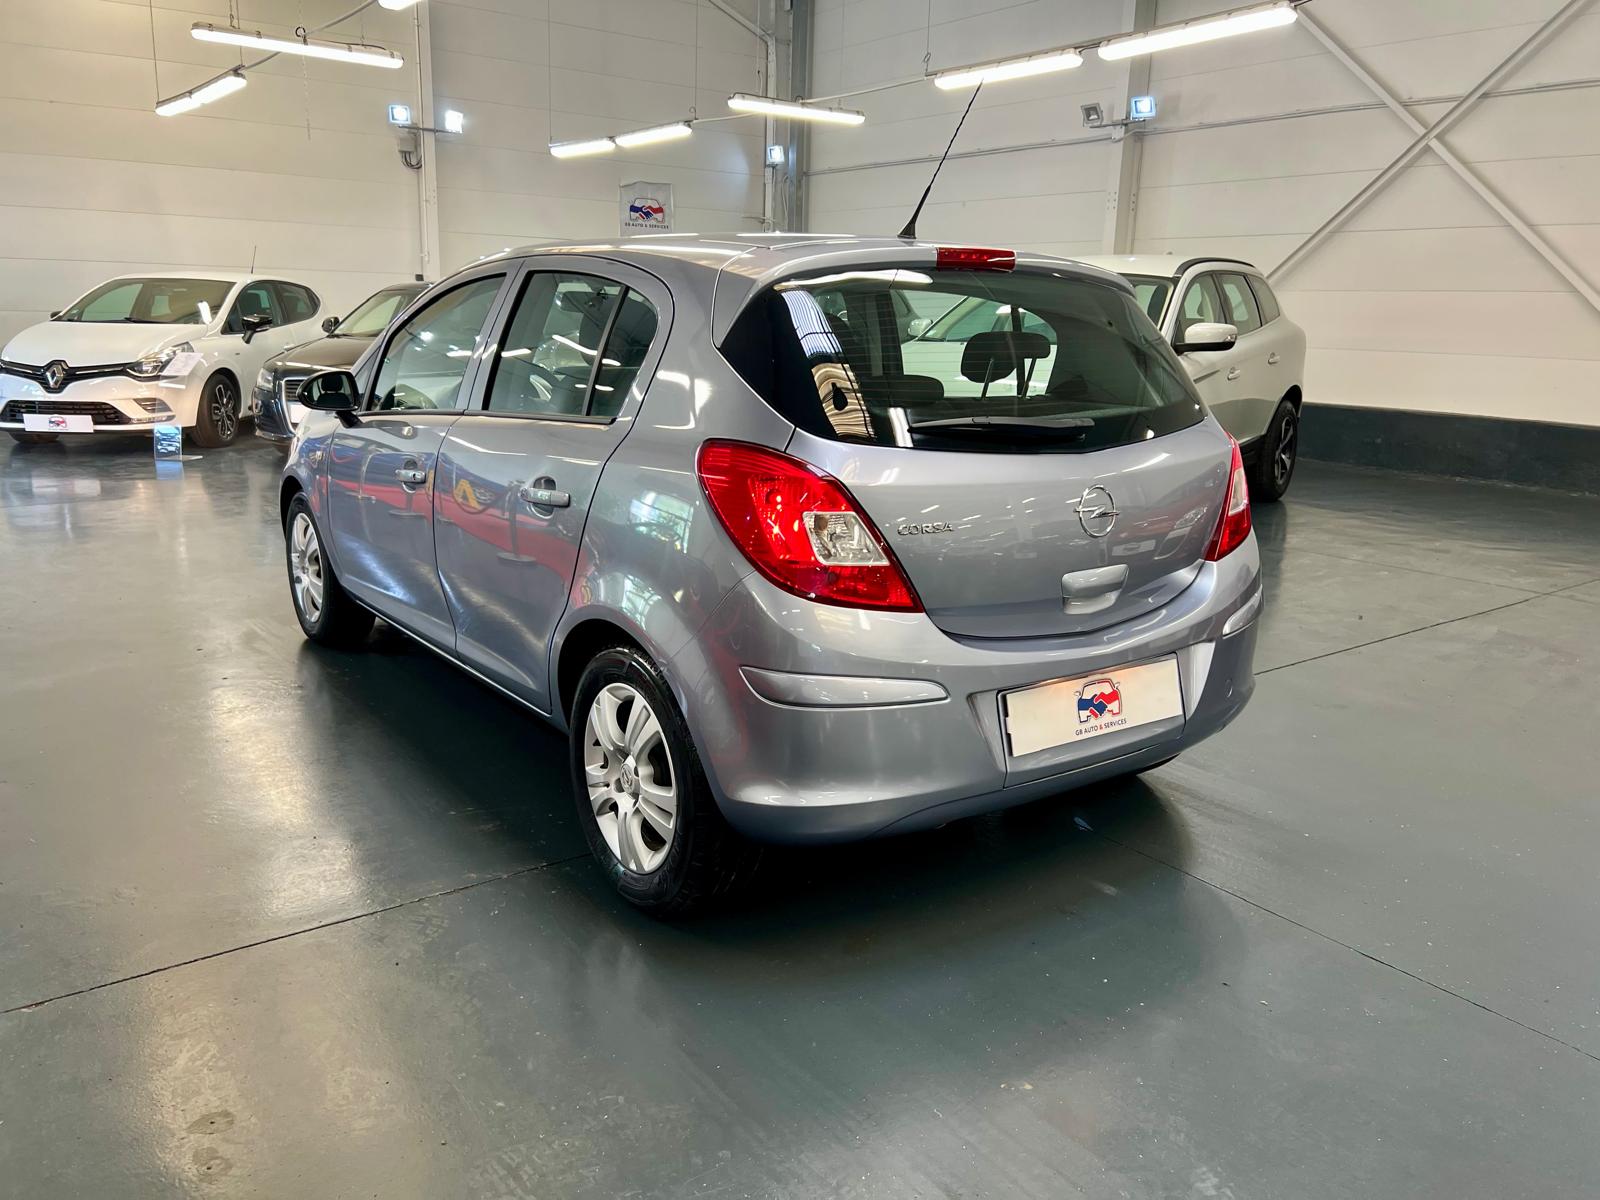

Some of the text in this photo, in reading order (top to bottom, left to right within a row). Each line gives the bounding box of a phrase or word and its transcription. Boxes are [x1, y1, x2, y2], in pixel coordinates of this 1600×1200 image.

[897, 521, 953, 535] CORSA
[1084, 725, 1098, 734] AUTO
[1104, 718, 1127, 729] SERVICES
